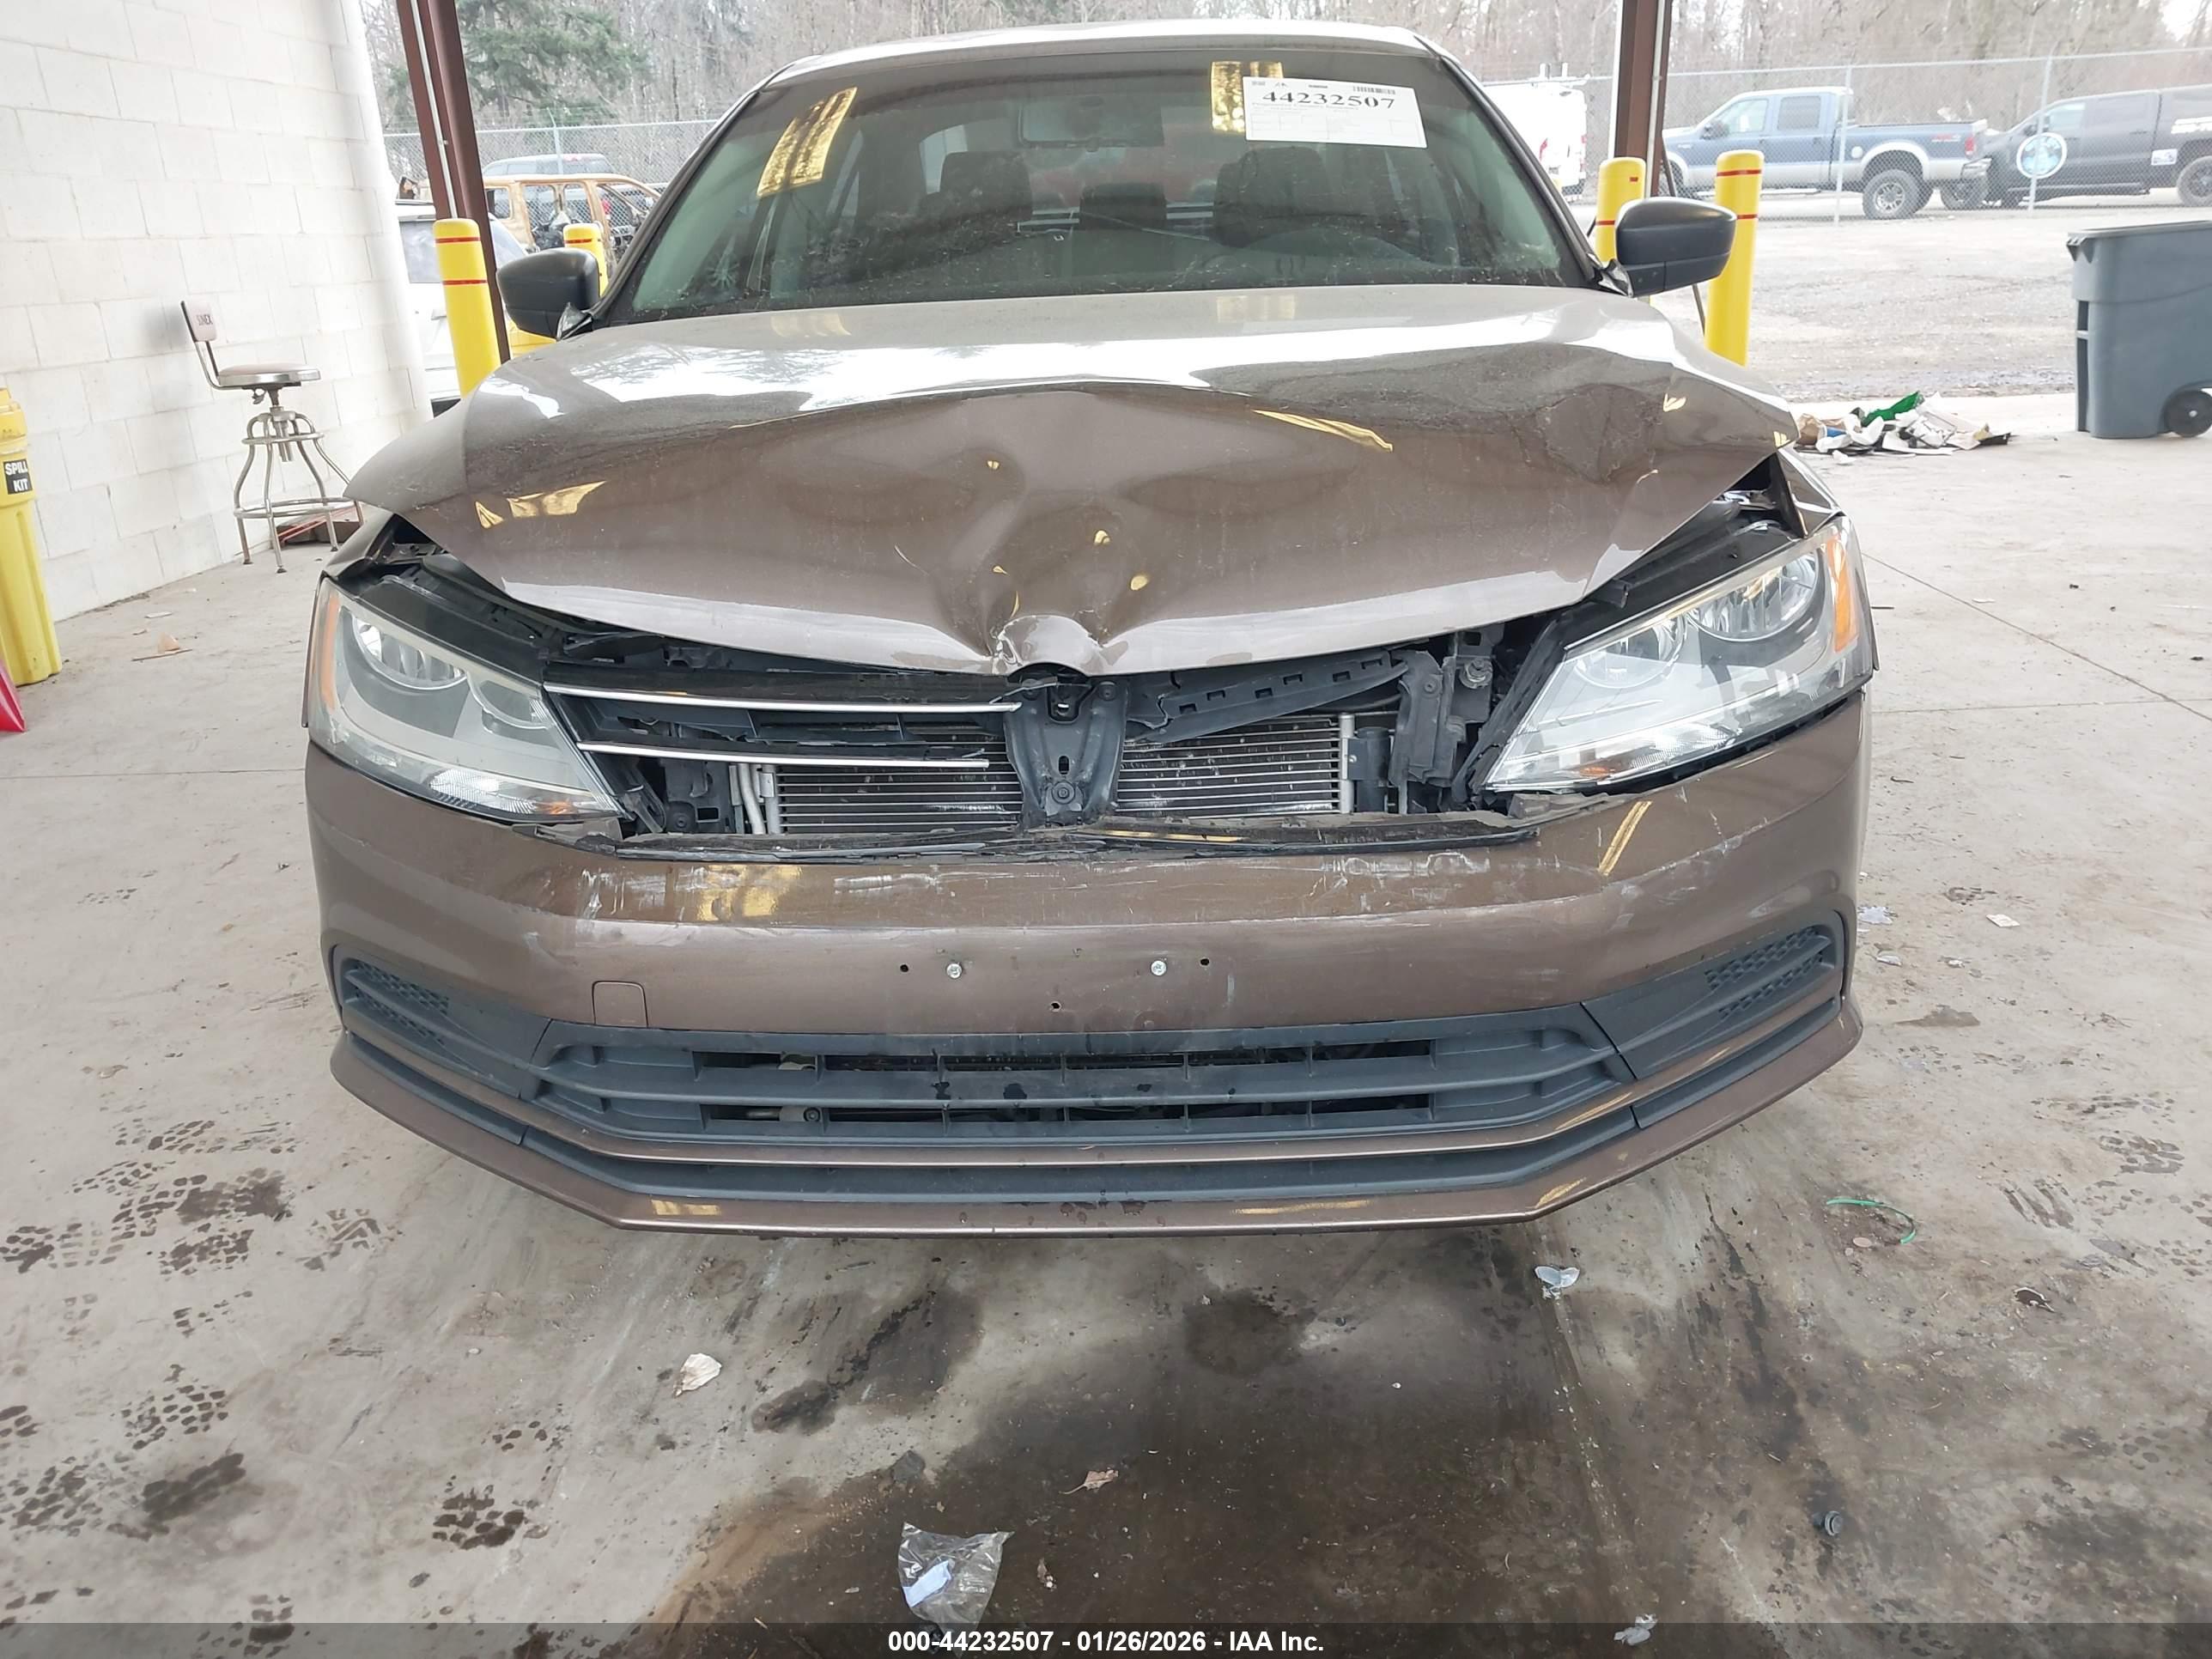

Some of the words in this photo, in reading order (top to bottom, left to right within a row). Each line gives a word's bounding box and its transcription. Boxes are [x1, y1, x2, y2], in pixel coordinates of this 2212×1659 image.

[1262, 92, 1395, 109] 44232507
[5, 460, 28, 475] SPILL
[13, 477, 28, 492] KIT
